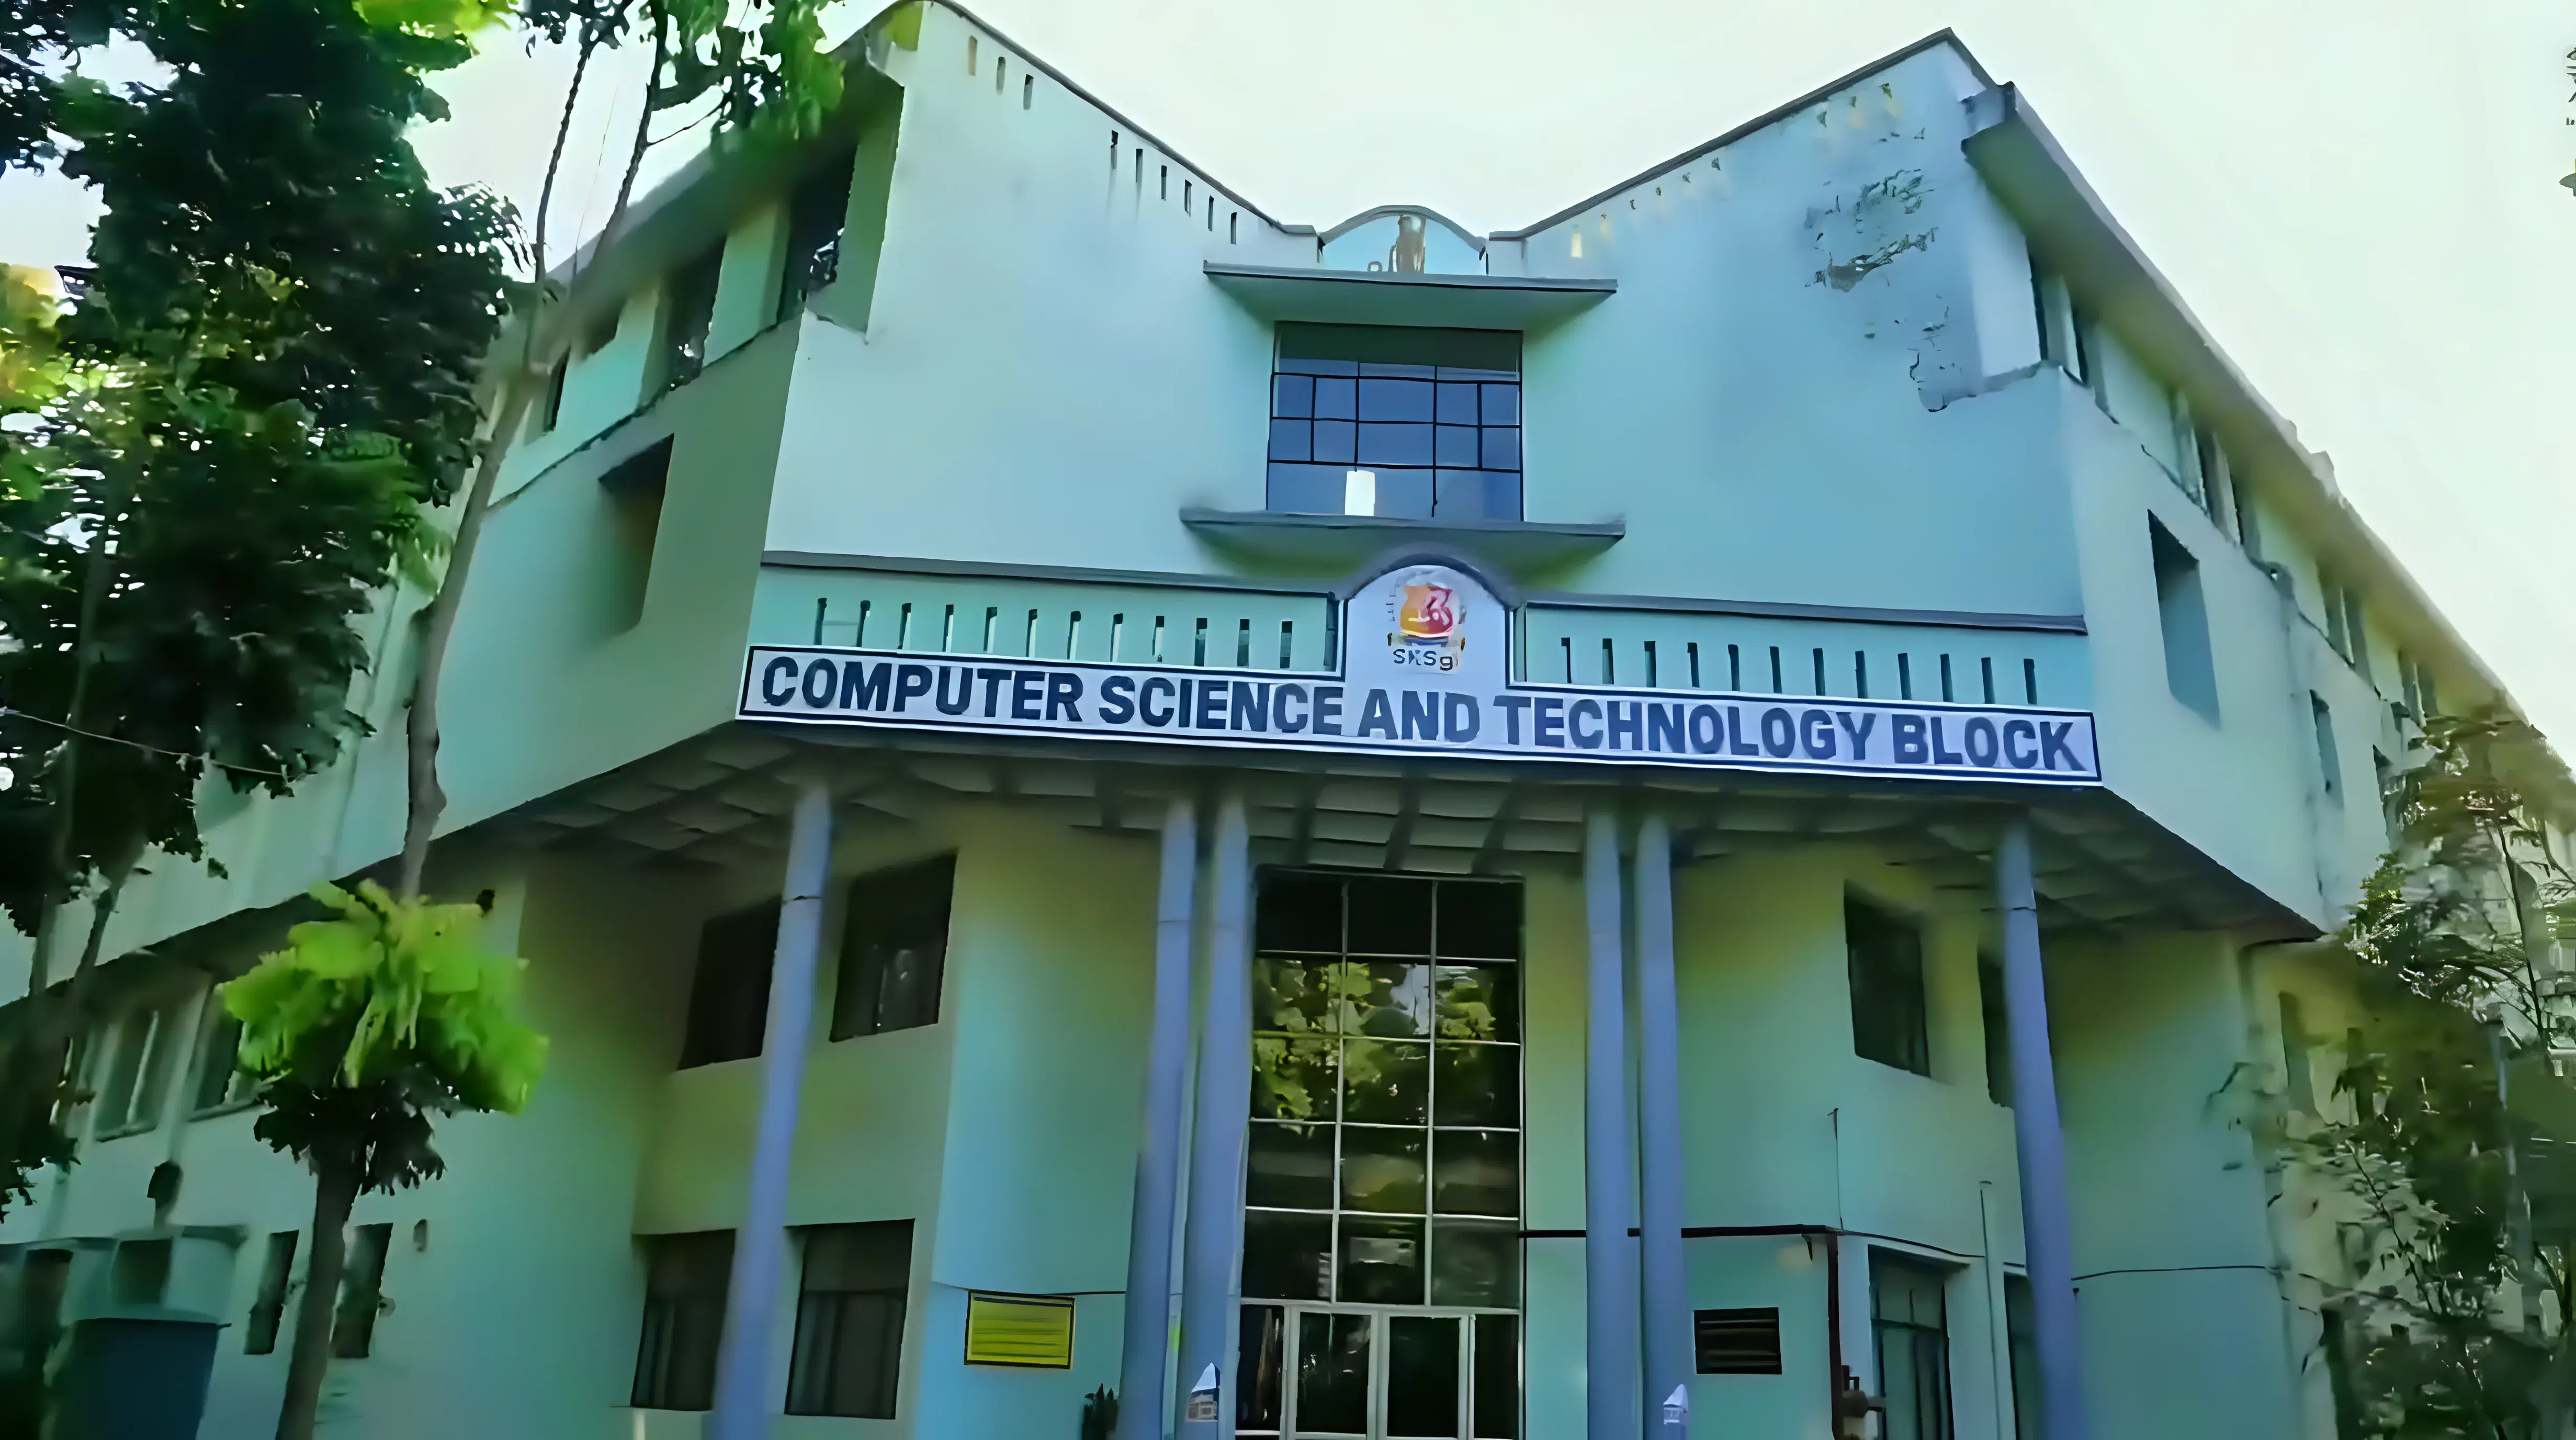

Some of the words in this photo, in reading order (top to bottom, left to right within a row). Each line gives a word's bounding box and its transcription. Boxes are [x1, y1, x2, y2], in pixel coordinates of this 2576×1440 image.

[762, 656, 1083, 722] COMPUTER
[1099, 676, 1343, 736] SCIENCE
[1359, 689, 1480, 743] AND
[1493, 695, 1877, 760] TECHNOLOGY
[1892, 714, 2087, 771] BLOCK
